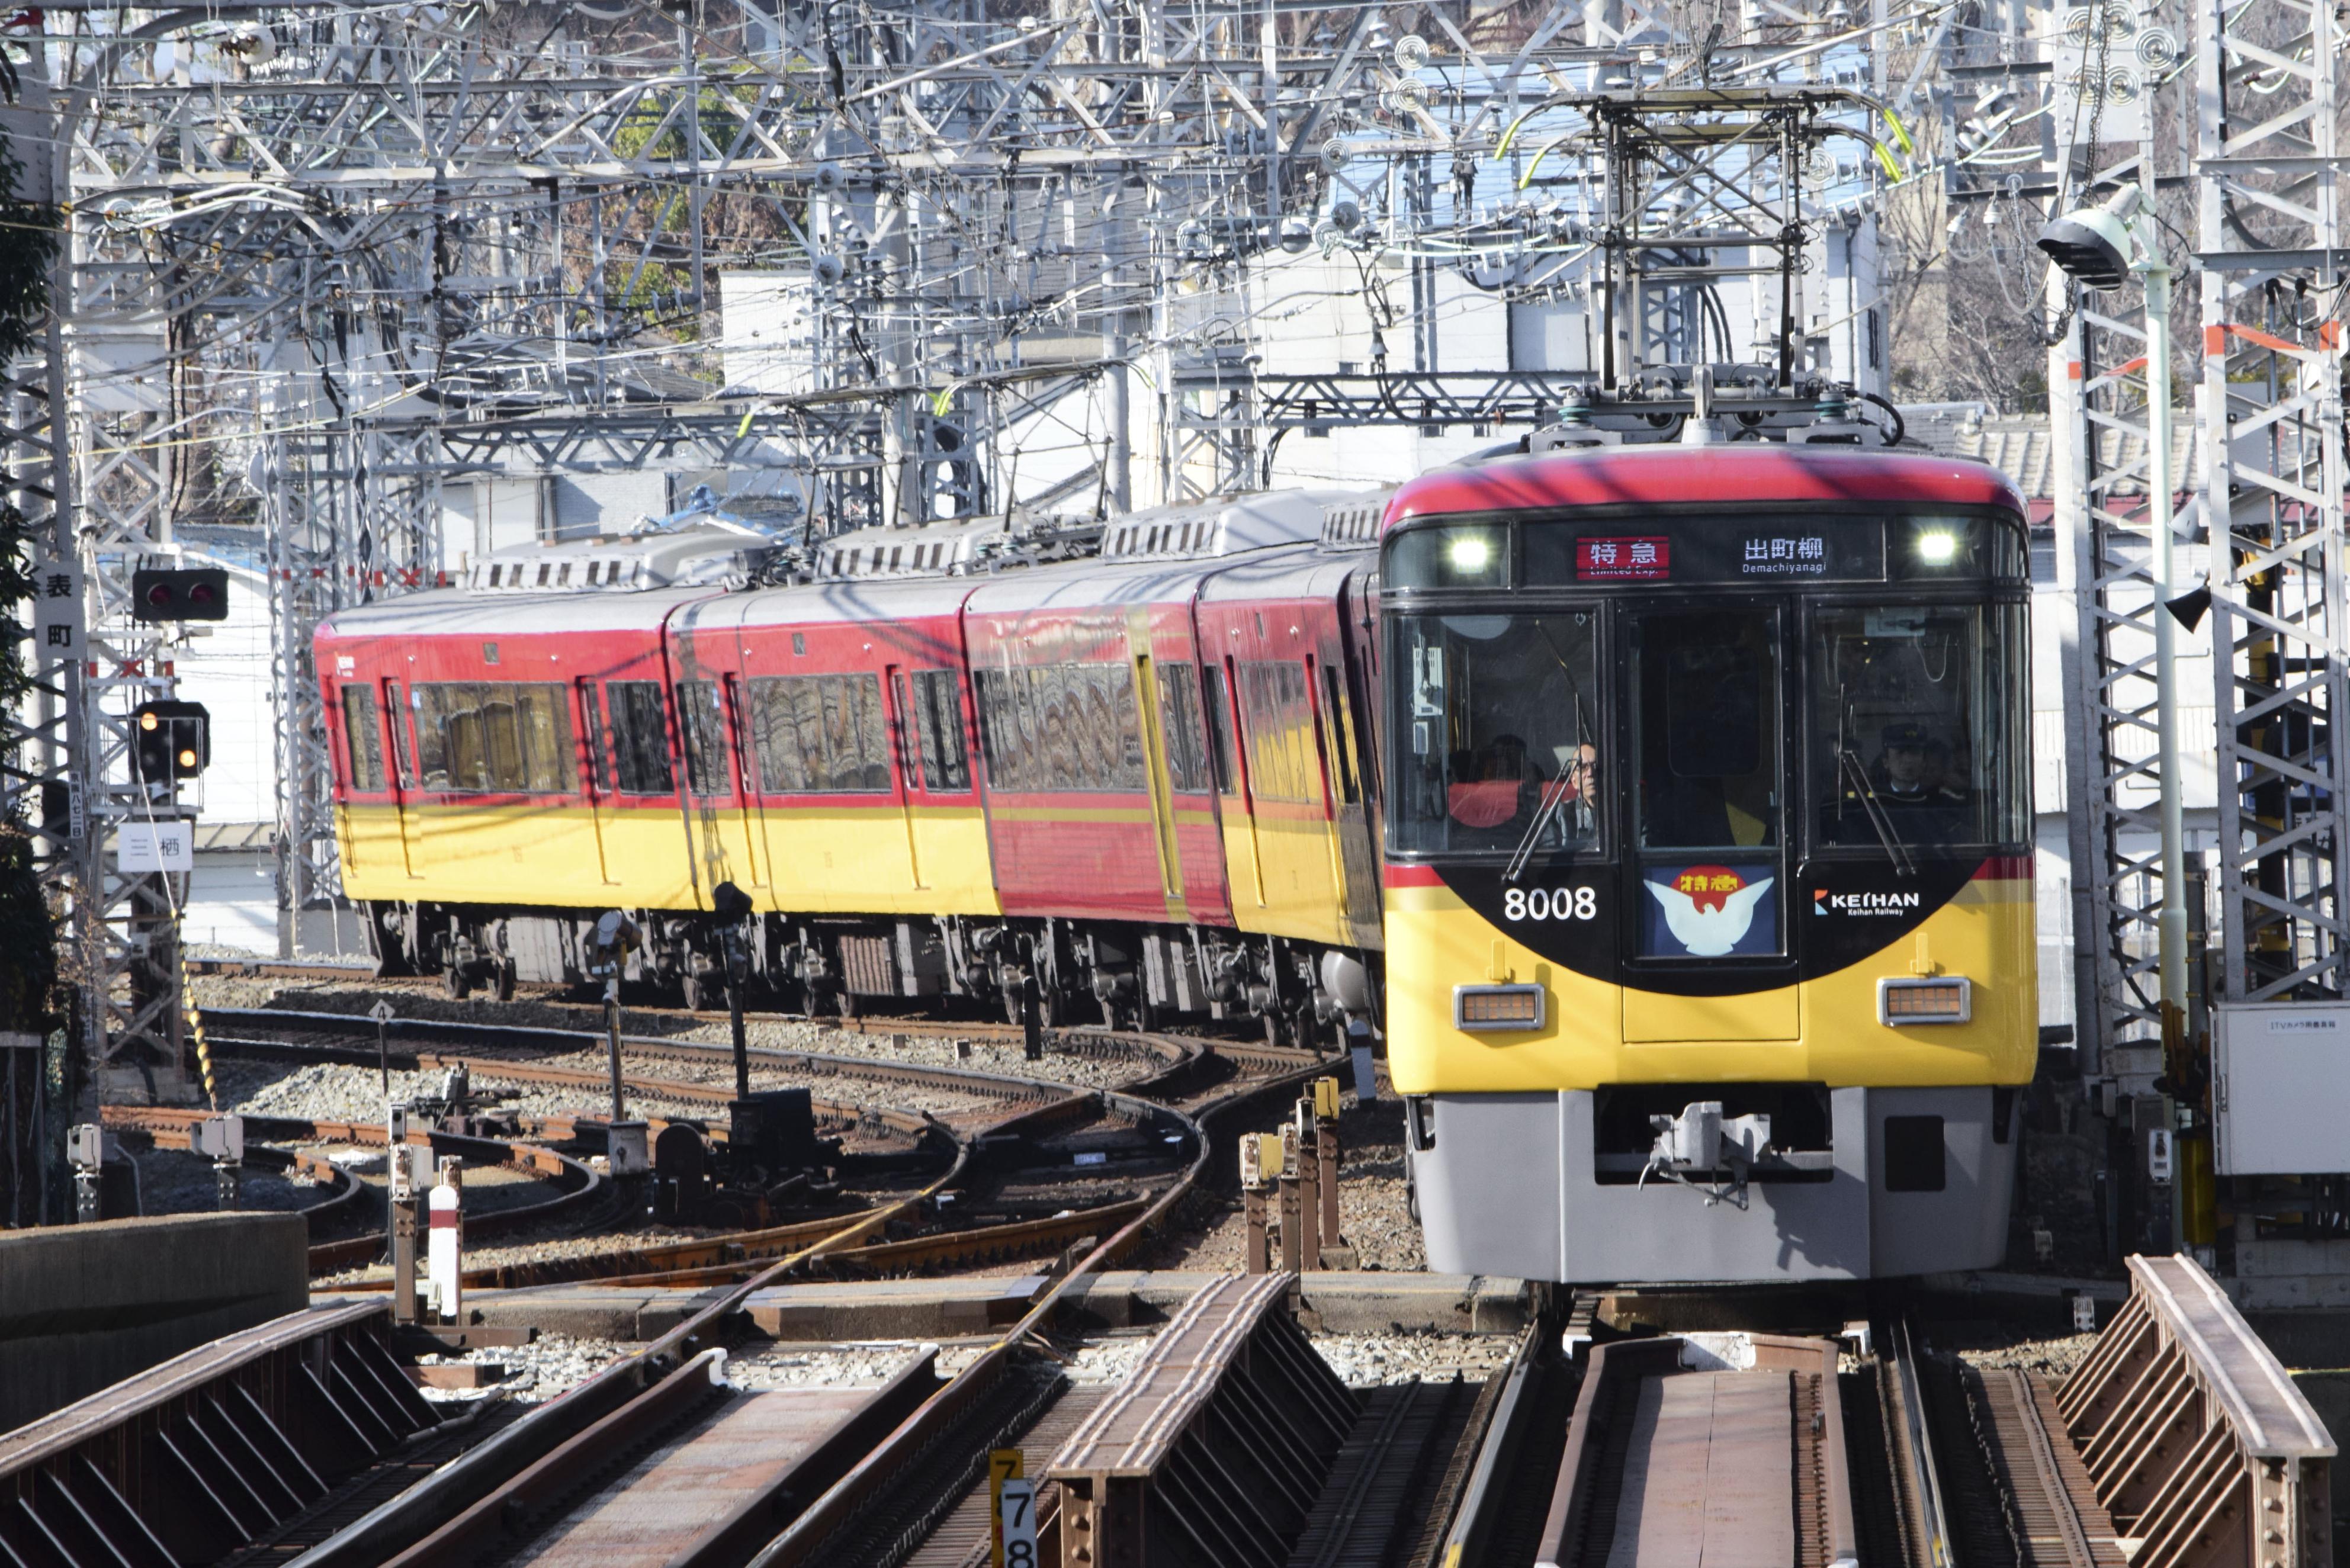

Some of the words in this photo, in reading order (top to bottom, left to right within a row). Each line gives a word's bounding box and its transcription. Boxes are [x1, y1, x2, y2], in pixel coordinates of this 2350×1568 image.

[1590, 540, 1657, 564] 特急
[1745, 537, 1823, 560] 出町柳
[1743, 562, 1826, 574] Demachiyanagi
[47, 574, 72, 647] 表町
[1681, 875, 1738, 892] 特急
[1505, 886, 1596, 921] 8008
[1831, 892, 1919, 908] KEIHAN
[1848, 908, 1873, 916] Keihan
[1875, 908, 1903, 917] Railway
